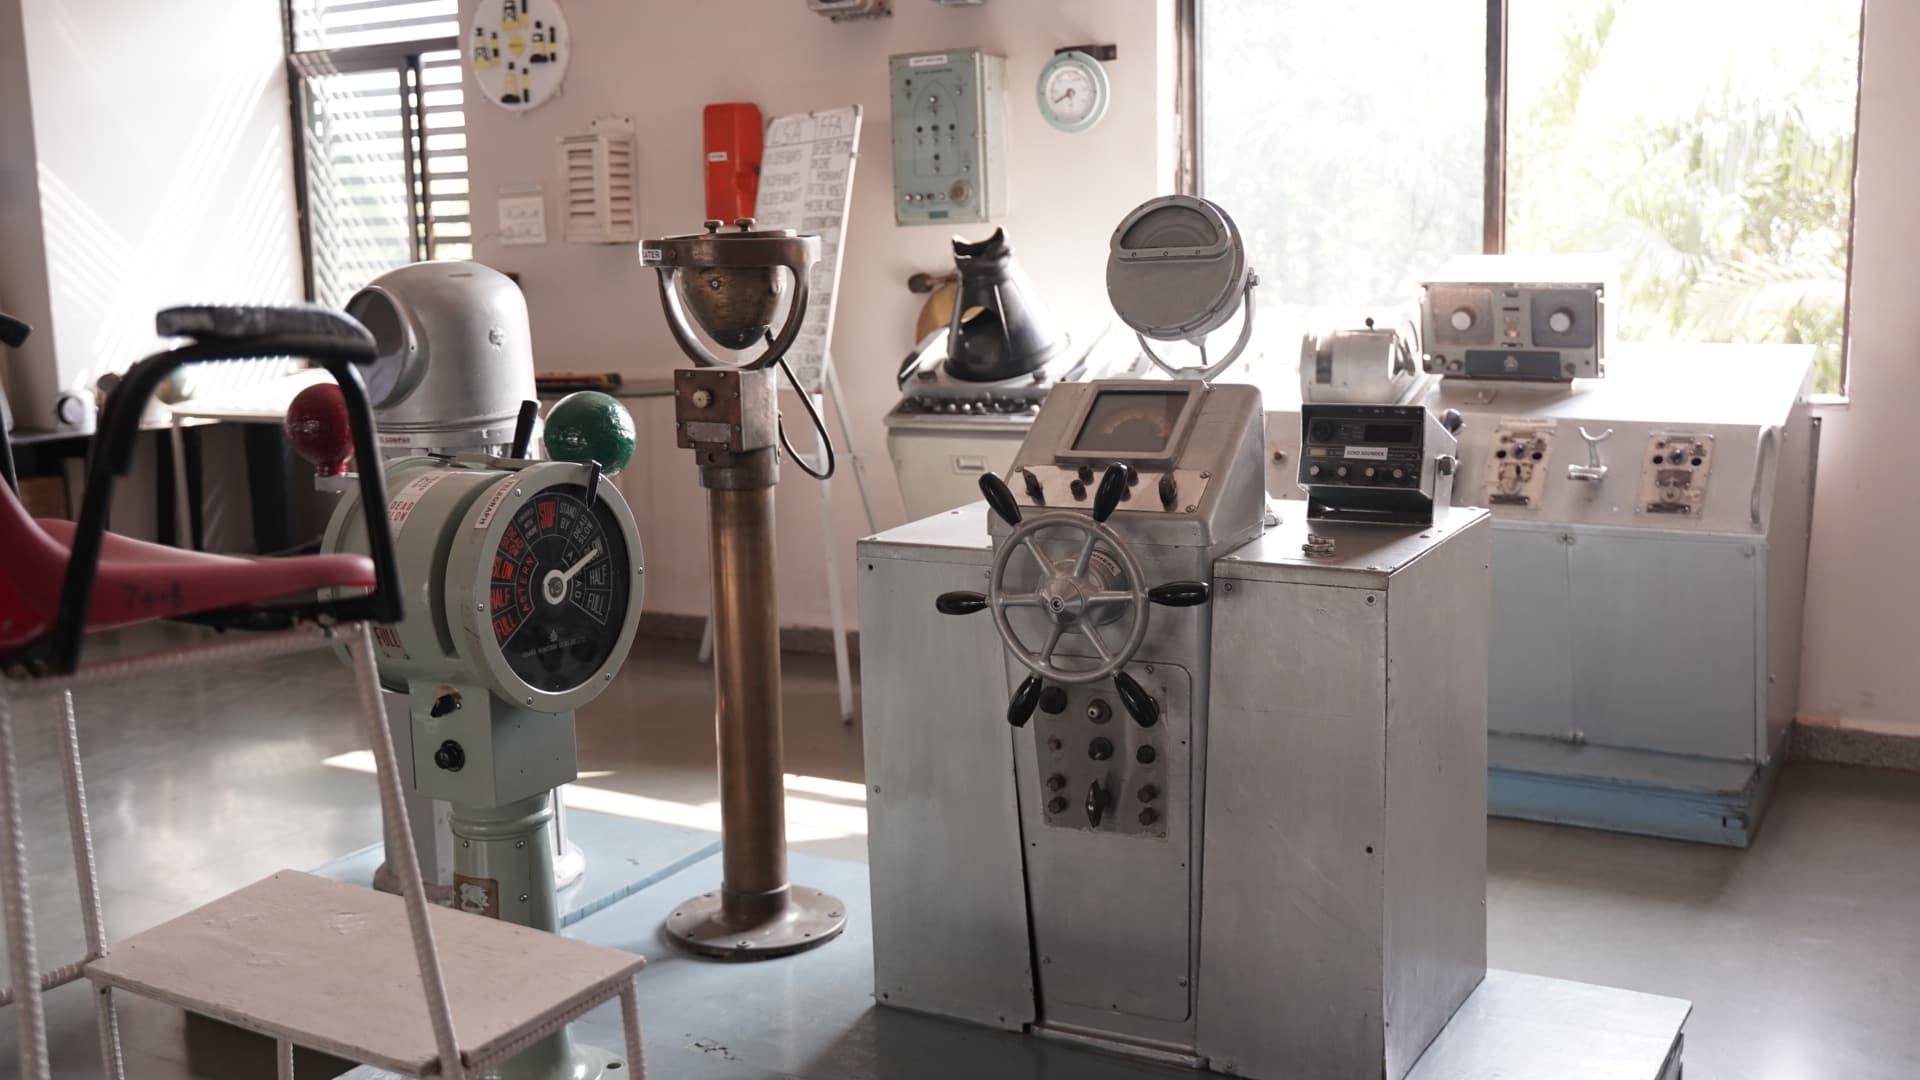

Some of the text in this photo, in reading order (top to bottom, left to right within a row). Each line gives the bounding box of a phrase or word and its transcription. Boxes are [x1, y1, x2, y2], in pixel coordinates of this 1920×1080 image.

[390, 501, 415, 510] DEAD
[480, 479, 516, 525] TELEGRAPH
[560, 502, 577, 518] STAND
[560, 517, 570, 529] BY
[573, 514, 588, 539] DEAD
[578, 520, 593, 544] SLOW
[1092, 553, 1115, 572] WHEEL
[589, 564, 608, 585] HALF
[586, 592, 604, 616] FULL
[374, 627, 401, 648] FULL
[494, 613, 518, 641] FULL
